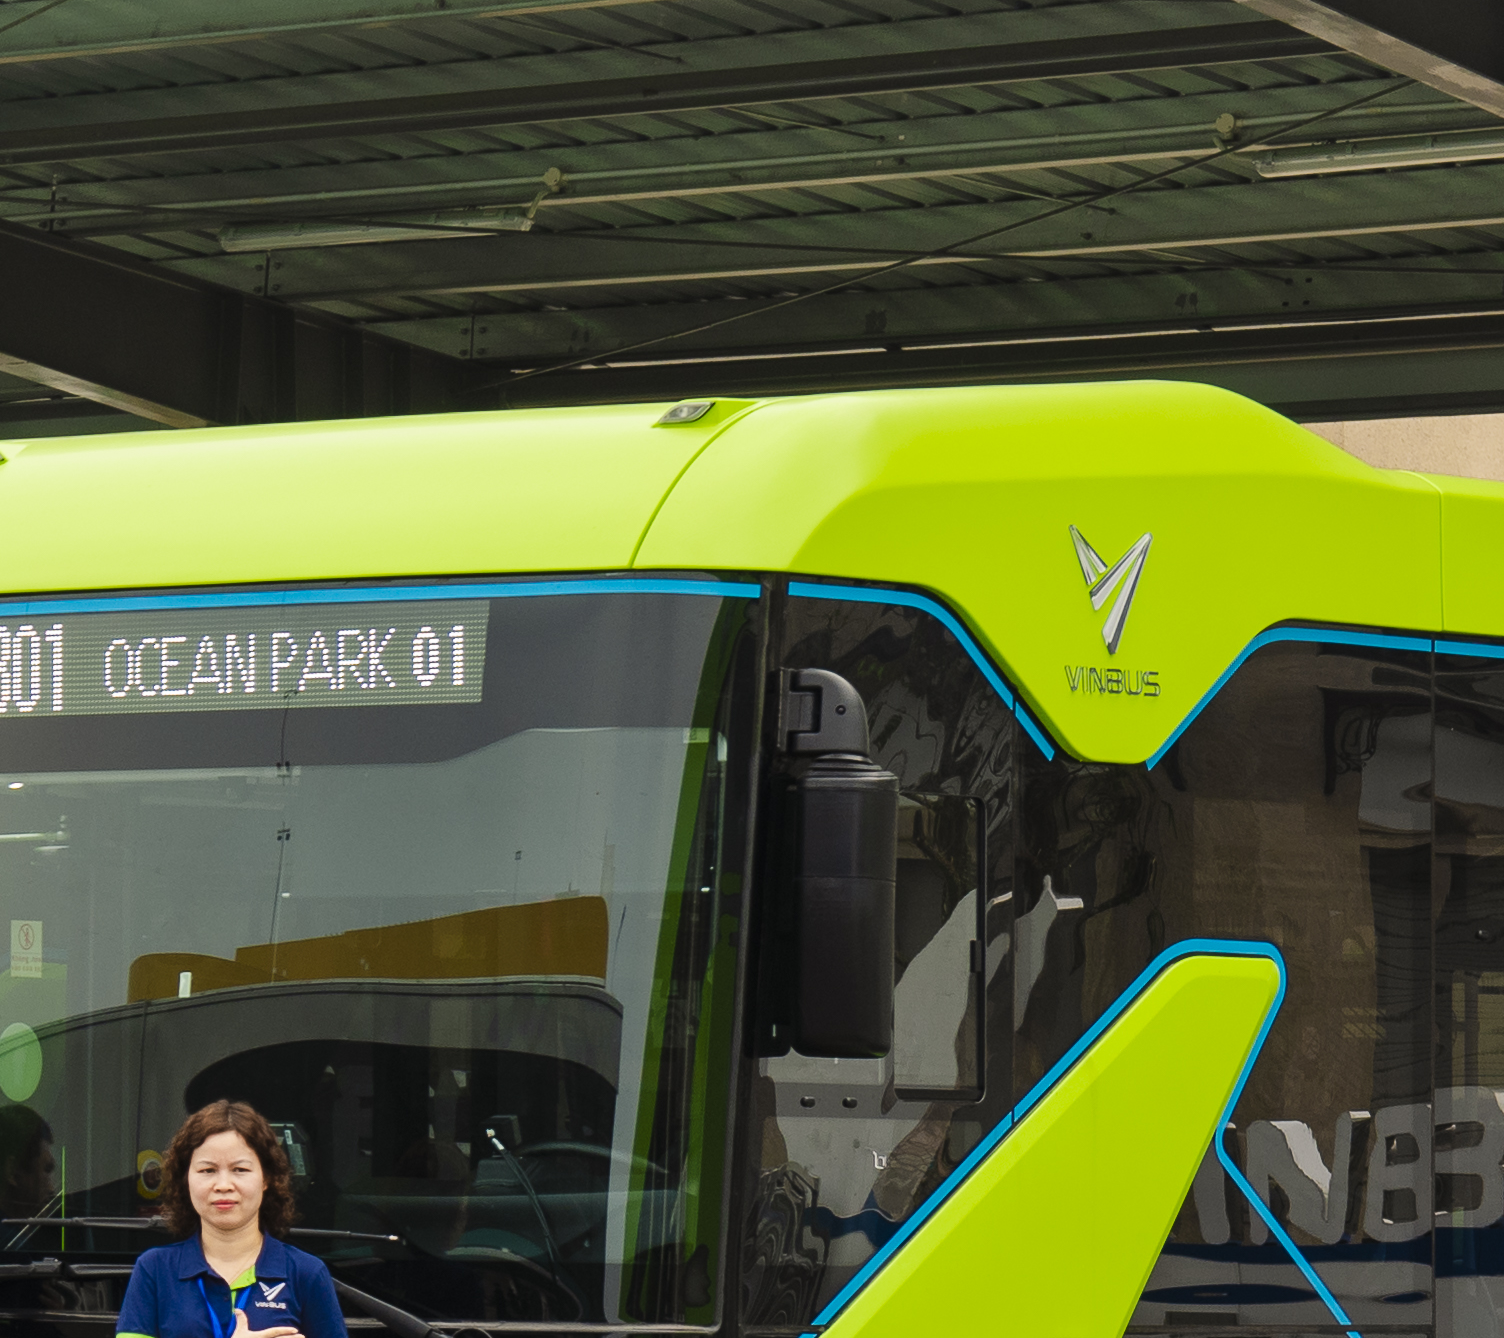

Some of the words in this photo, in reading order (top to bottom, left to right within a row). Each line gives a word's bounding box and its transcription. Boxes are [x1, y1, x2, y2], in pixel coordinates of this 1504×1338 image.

[103, 632, 257, 698] OCEAN
[269, 627, 396, 694] PARK
[410, 624, 465, 687] 01
[1064, 665, 1161, 697] VINBUS
